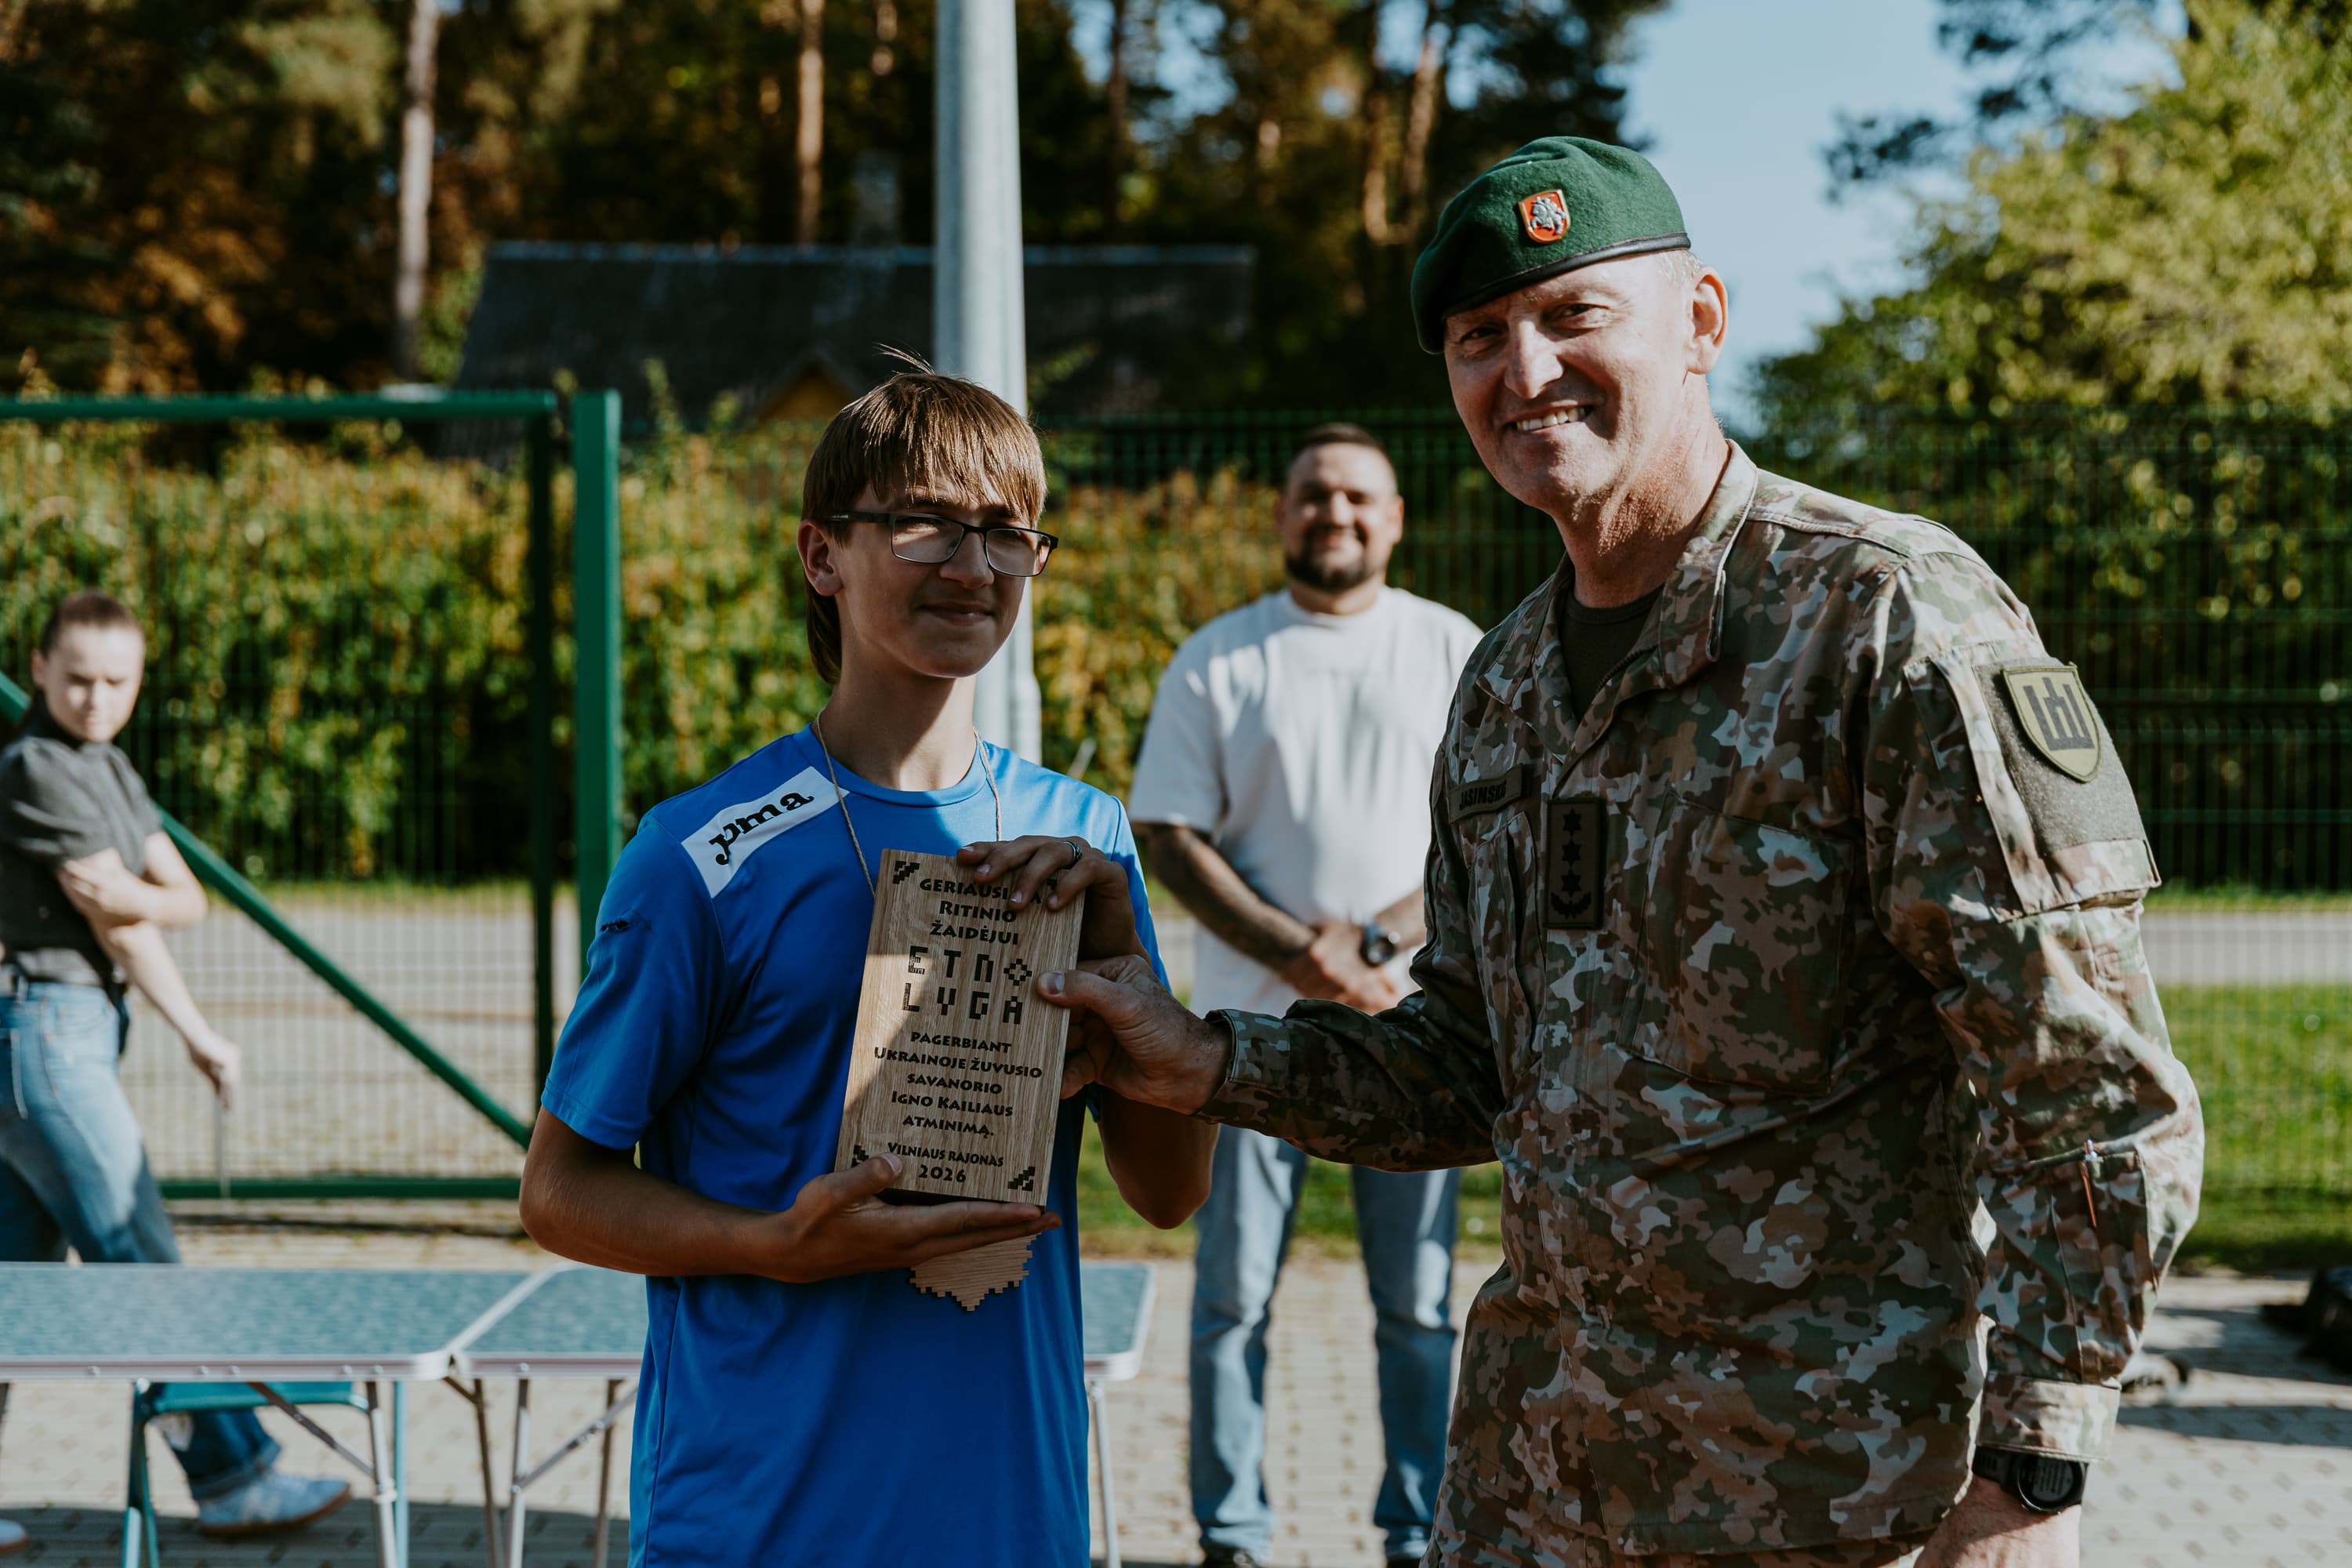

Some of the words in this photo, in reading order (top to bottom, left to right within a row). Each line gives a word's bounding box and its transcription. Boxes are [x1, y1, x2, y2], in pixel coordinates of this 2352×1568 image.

[920, 878, 1041, 904] GERIAUSI
[939, 901, 1017, 923] RITINIO
[930, 920, 1018, 945] ŽAIDĖJUI
[911, 1032, 1011, 1053] PAGERBIANT
[874, 1047, 967, 1070] UKRAINOJE
[970, 1057, 1043, 1078] ŽUVUSIO
[907, 1073, 1003, 1094] SAVANORIO
[891, 1091, 933, 1107] IGNO
[938, 1094, 1013, 1117] KAILIAUS
[902, 1115, 994, 1139] ATMINIMĄ.
[887, 1142, 946, 1160] VILNIAUS
[948, 1150, 1004, 1167] RAJONAS
[918, 1164, 967, 1183] 2026
